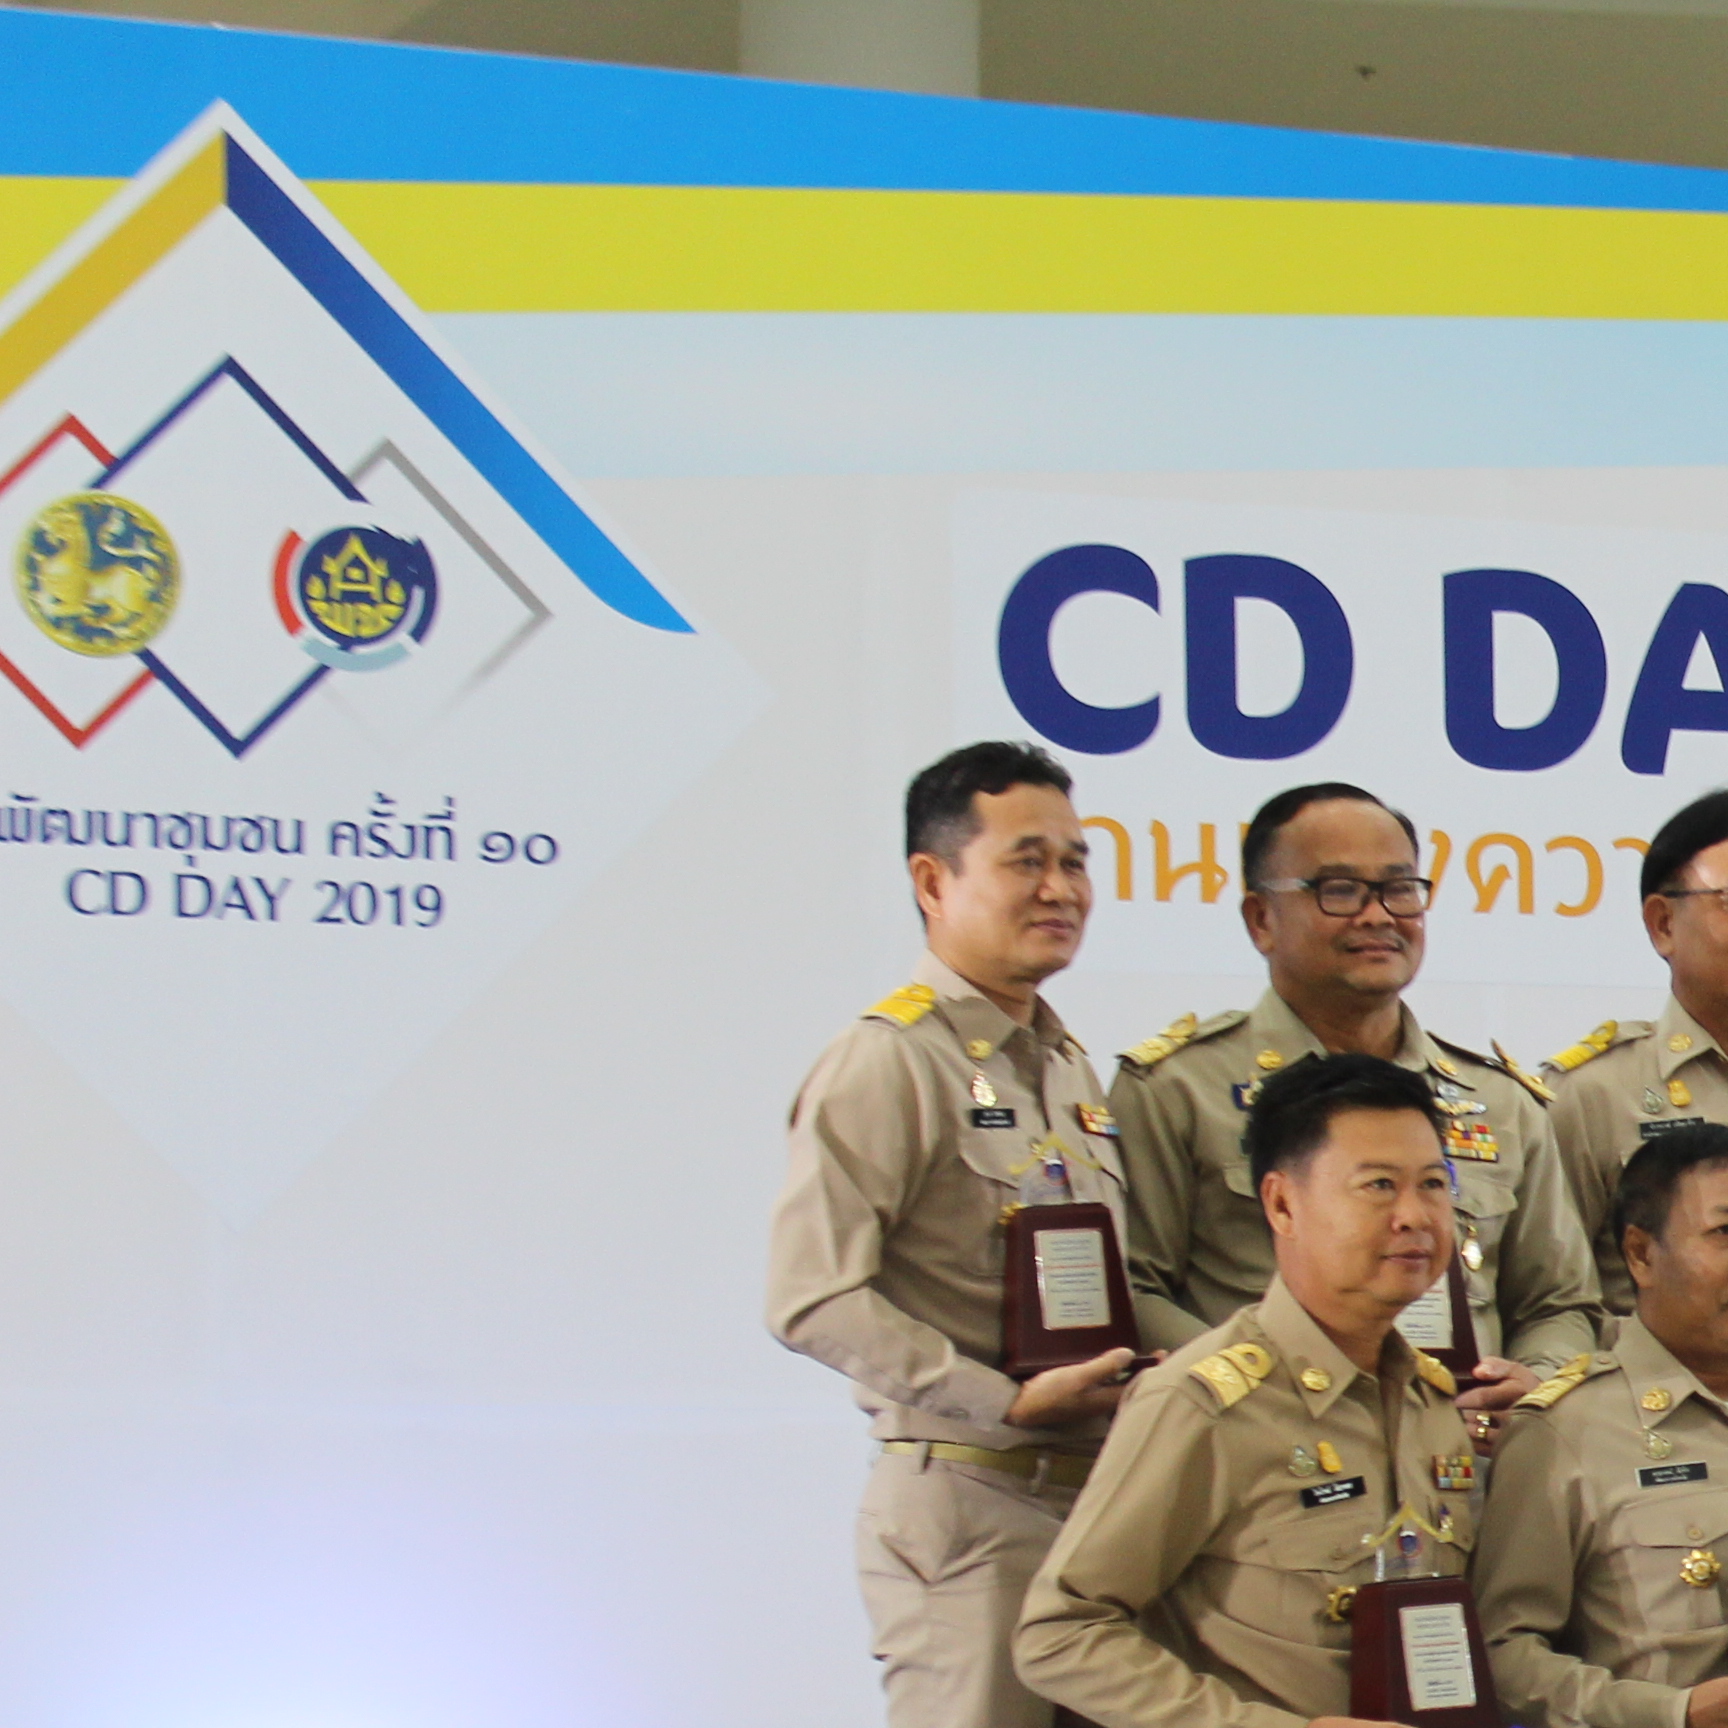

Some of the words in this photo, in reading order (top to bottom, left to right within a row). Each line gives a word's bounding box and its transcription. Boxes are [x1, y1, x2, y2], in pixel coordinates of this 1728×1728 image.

[996, 542, 1355, 761] CD
[327, 790, 457, 862] ครั้งที่
[478, 830, 560, 866] ๑๐
[64, 868, 150, 917] CD
[173, 872, 292, 921] DAY
[313, 879, 445, 929] 2019
